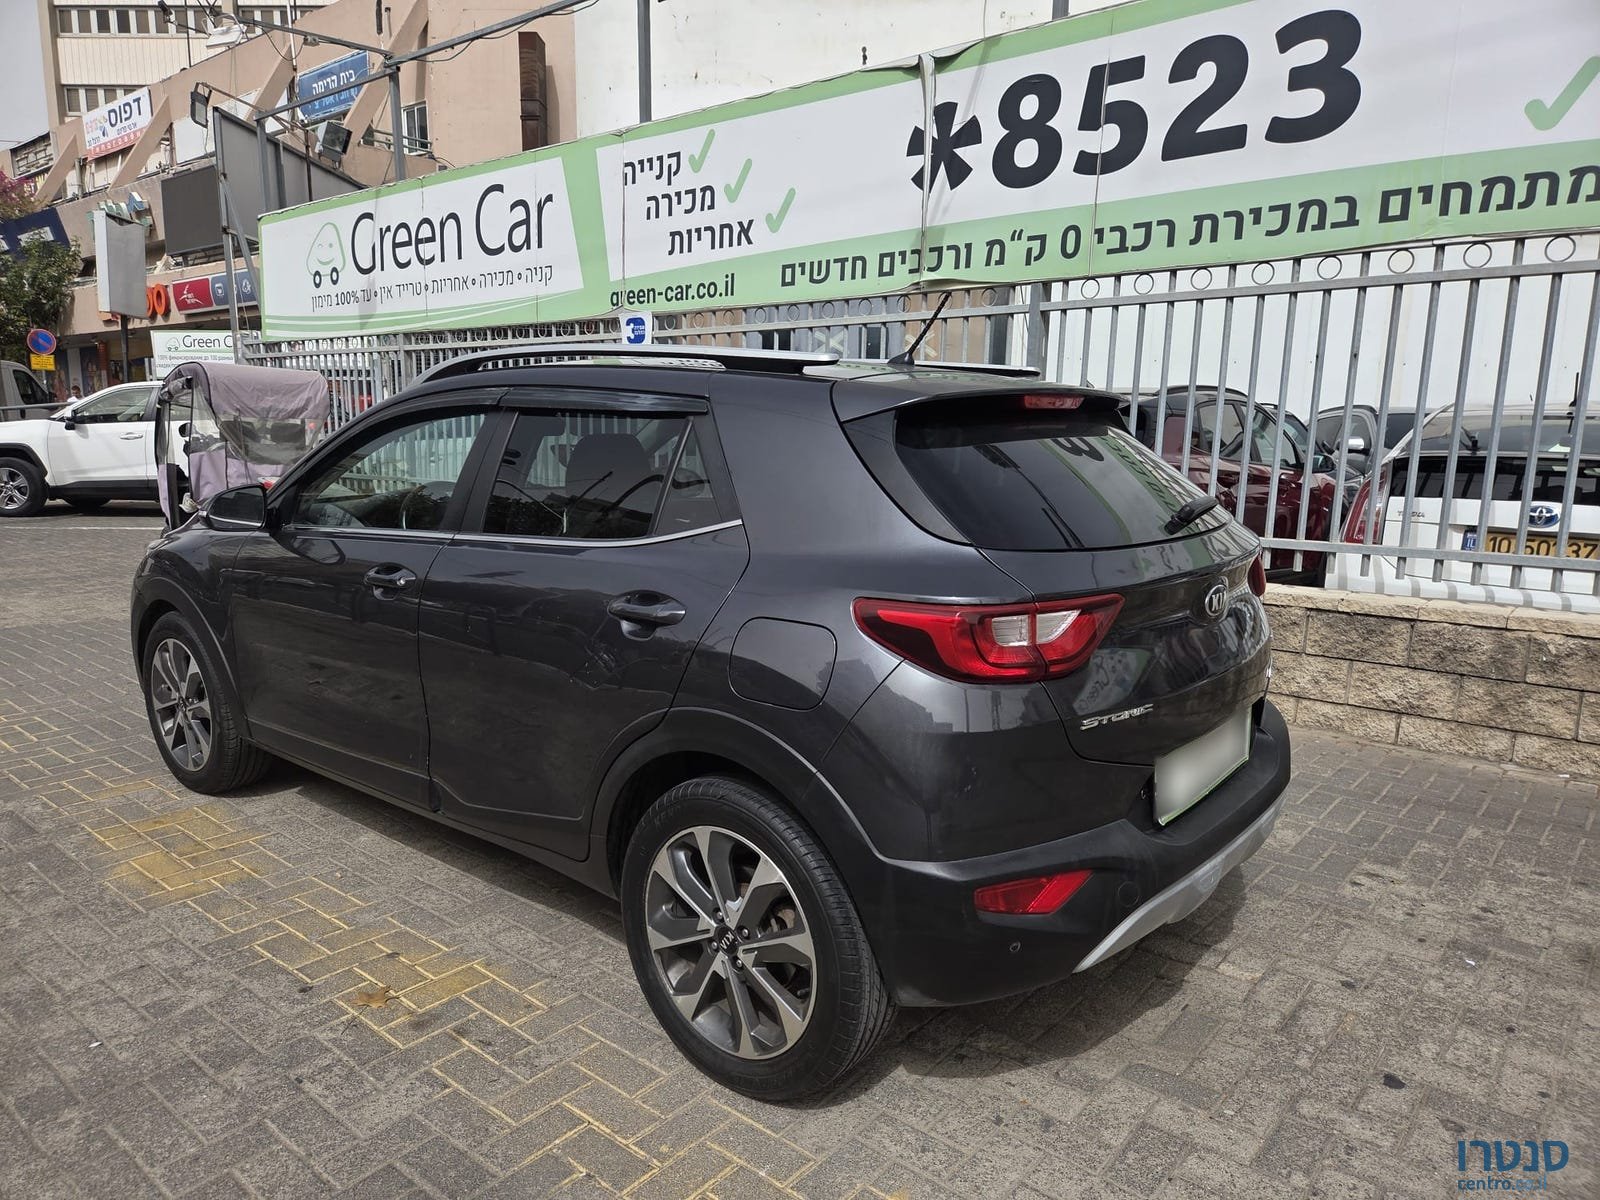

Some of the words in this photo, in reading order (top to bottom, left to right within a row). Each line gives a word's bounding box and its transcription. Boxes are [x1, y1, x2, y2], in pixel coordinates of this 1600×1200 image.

[340, 69, 356, 86] בית
[107, 96, 142, 128] דפוס
[624, 151, 681, 186] קנייה
[646, 184, 716, 220] מכירה
[1378, 165, 1600, 224] מתמחים
[351, 211, 463, 275] Green
[475, 183, 554, 256] Car
[1189, 195, 1360, 246] במכירת
[668, 219, 755, 256] אחריות
[1060, 224, 1082, 260] 0
[1095, 217, 1176, 255] רכבי
[781, 254, 867, 288] חדשים
[877, 241, 972, 278] ורכבים
[396, 281, 422, 297] טרייד
[431, 275, 469, 293] אחריות
[479, 269, 514, 288] מכירה
[525, 264, 553, 287] קניה
[311, 293, 333, 312] מימון
[335, 290, 360, 306] 100%
[360, 287, 372, 303] עד
[379, 284, 393, 304] אין
[182, 334, 221, 348] Green
[1080, 703, 1154, 731] STONIC
[720, 931, 735, 950] KIA
